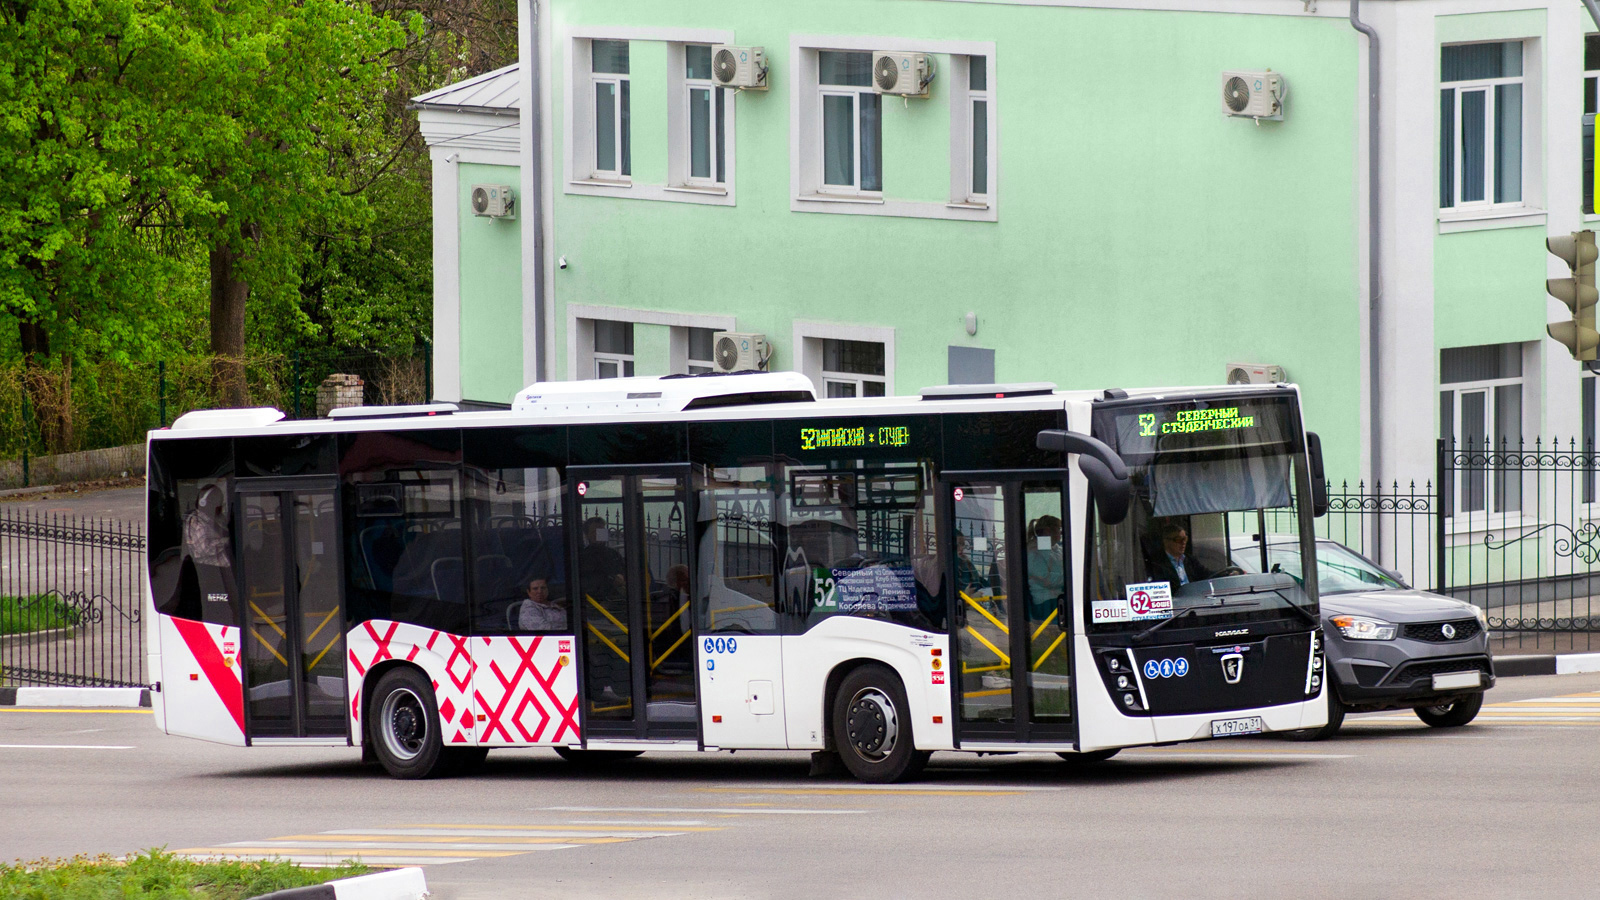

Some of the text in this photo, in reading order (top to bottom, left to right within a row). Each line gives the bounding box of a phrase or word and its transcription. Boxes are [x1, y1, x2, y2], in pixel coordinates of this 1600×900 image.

[1176, 407, 1239, 422] СЕВЕРНЫЙ
[1138, 413, 1156, 437] 52
[1161, 416, 1254, 434] СТУДЕНЧЕСКИЙ
[801, 428, 816, 450] 52
[831, 568, 873, 577] Северный
[814, 577, 837, 607] 52
[1129, 584, 1168, 592] СЕВЕРНЫЙ
[1132, 594, 1149, 611] 52
[1095, 608, 1127, 619] БОШЕ
